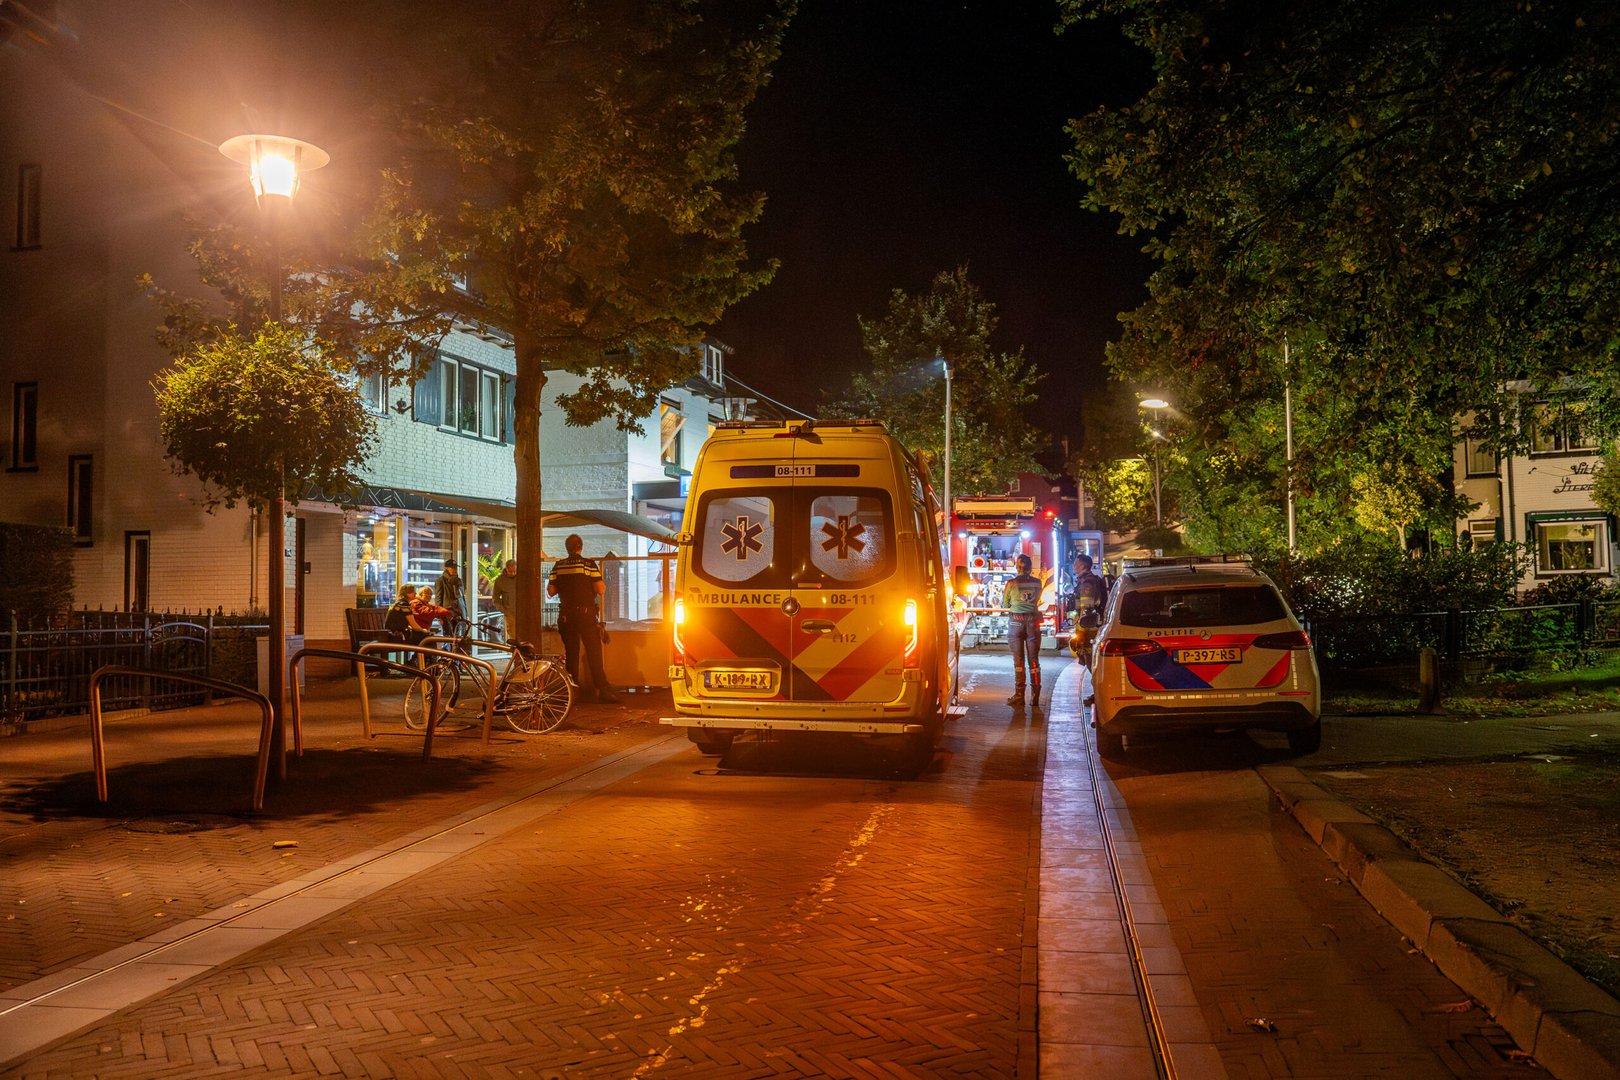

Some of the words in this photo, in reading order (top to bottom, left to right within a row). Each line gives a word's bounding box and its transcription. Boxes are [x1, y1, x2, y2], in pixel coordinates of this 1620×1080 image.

[777, 466, 812, 476] 08-111
[687, 593, 781, 605] AMBULANCE
[830, 593, 875, 605] 08-111
[1147, 629, 1195, 637] POLITIE
[1183, 650, 1236, 661] P-397-RS
[714, 673, 767, 685] K-189-RX
